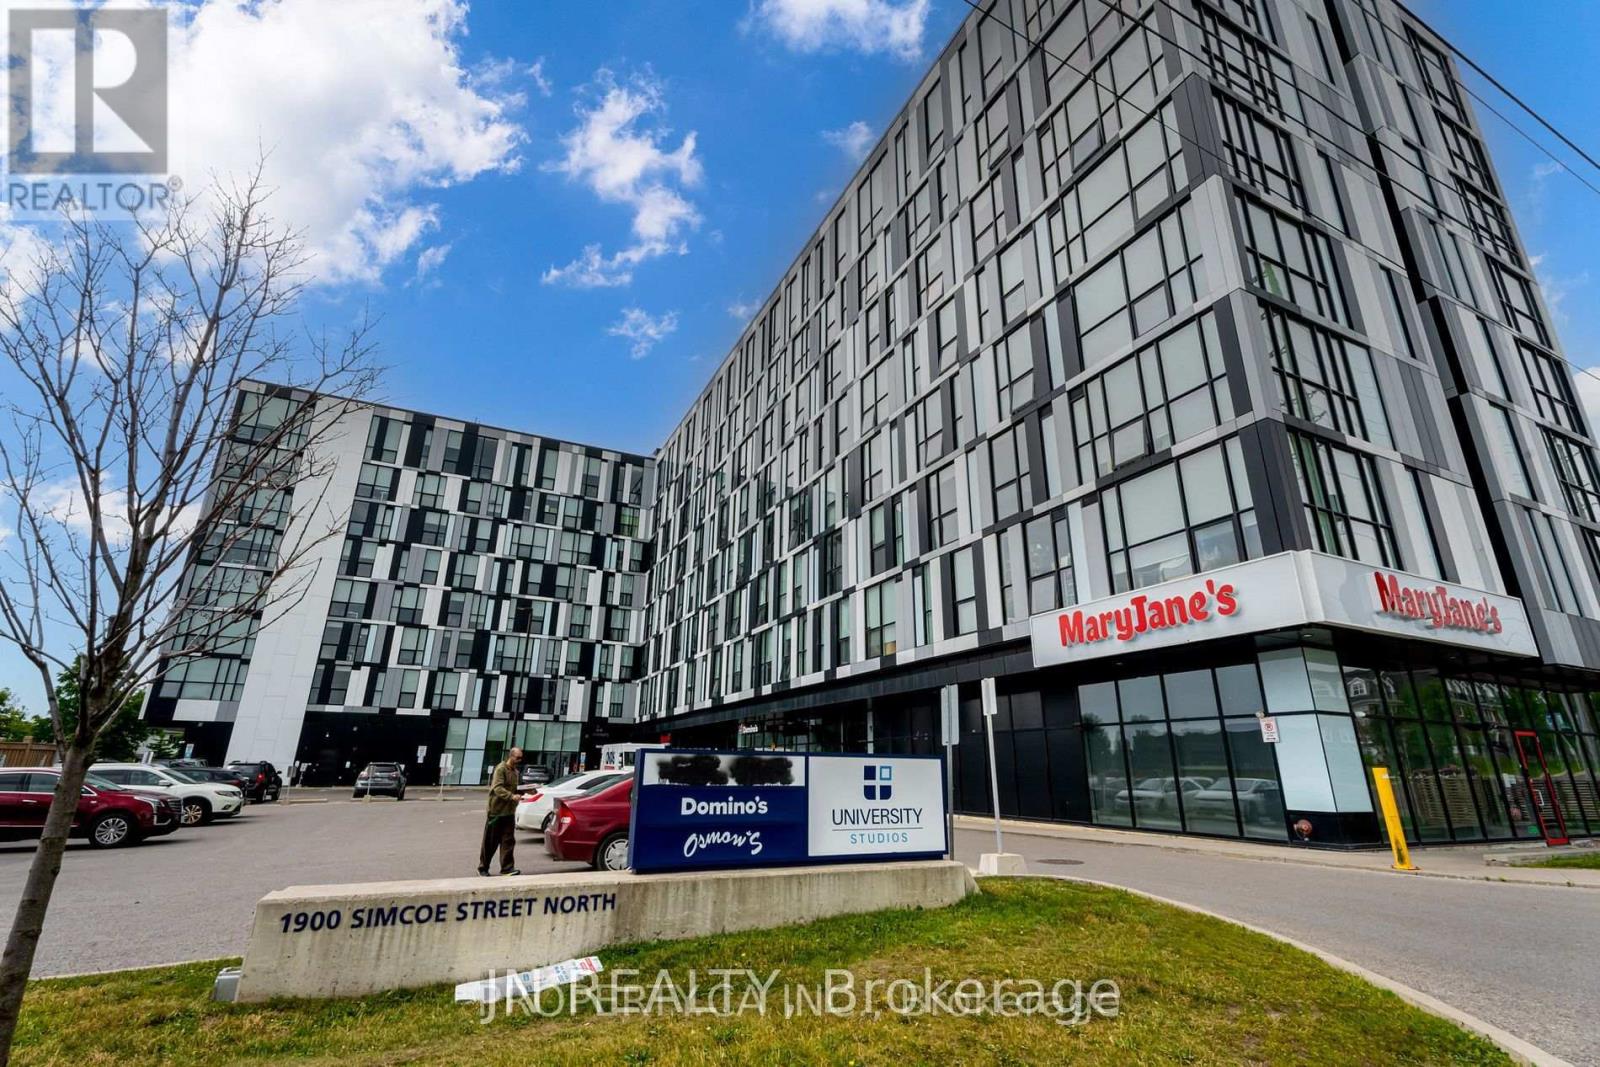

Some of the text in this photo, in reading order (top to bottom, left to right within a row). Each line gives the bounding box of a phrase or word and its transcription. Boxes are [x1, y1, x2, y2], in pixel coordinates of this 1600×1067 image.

[1058, 578, 1238, 647] MaryJane's
[1374, 571, 1503, 634] MaryJane's
[680, 795, 769, 816] Domino's
[832, 807, 923, 826] UNIVERSITY
[683, 830, 763, 858] Osmow's
[850, 832, 909, 845] STUDIOS
[280, 893, 617, 934] 1900 SIMCOE STREET NORTH
